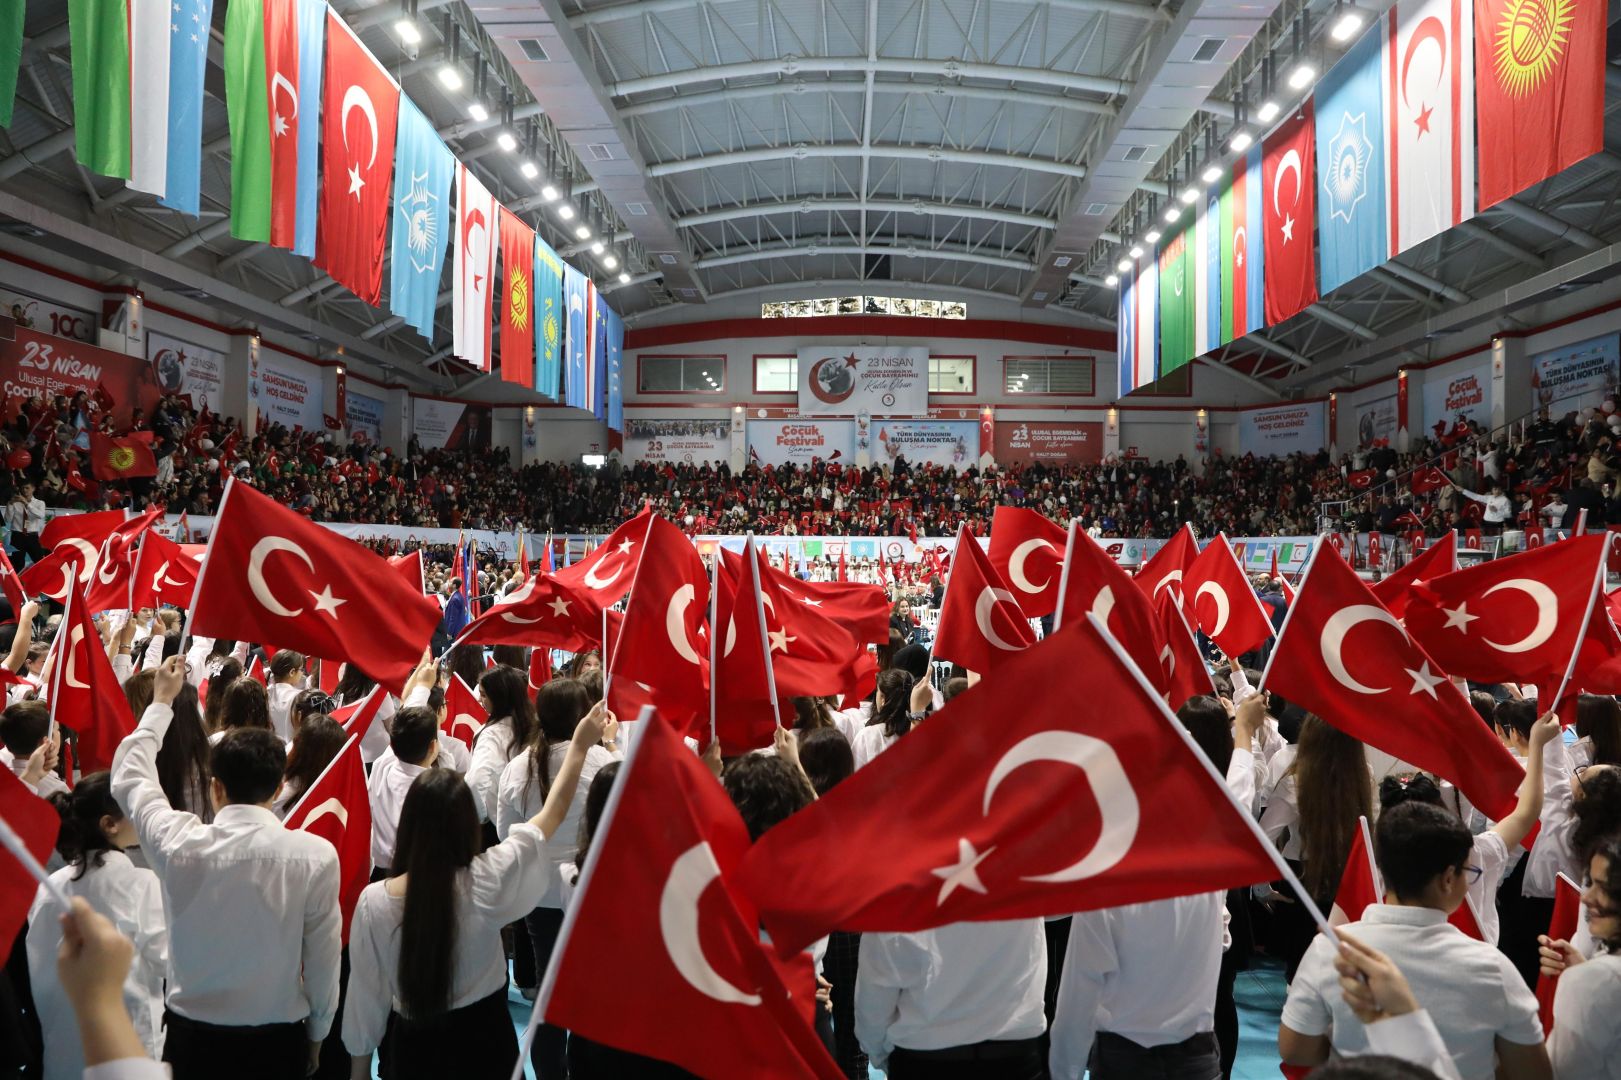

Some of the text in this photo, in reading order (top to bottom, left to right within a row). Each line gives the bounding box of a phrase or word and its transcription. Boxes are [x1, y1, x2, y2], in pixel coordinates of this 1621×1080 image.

[19, 341, 102, 381] 23 NİSAN
[868, 356, 914, 367] 23 NİSAN
[19, 371, 45, 385] Ulusal
[1546, 368, 1562, 379] TÜRK
[4, 380, 43, 400] Çocuk
[266, 386, 279, 399] HOŞ
[1448, 375, 1479, 398] Çocuk
[1445, 387, 1482, 411] Festivali
[782, 424, 819, 437] Çocuk
[1012, 429, 1028, 441] 23
[648, 440, 663, 452] 23
[776, 435, 825, 446] Festivali
[1009, 441, 1031, 449] NİSAN
